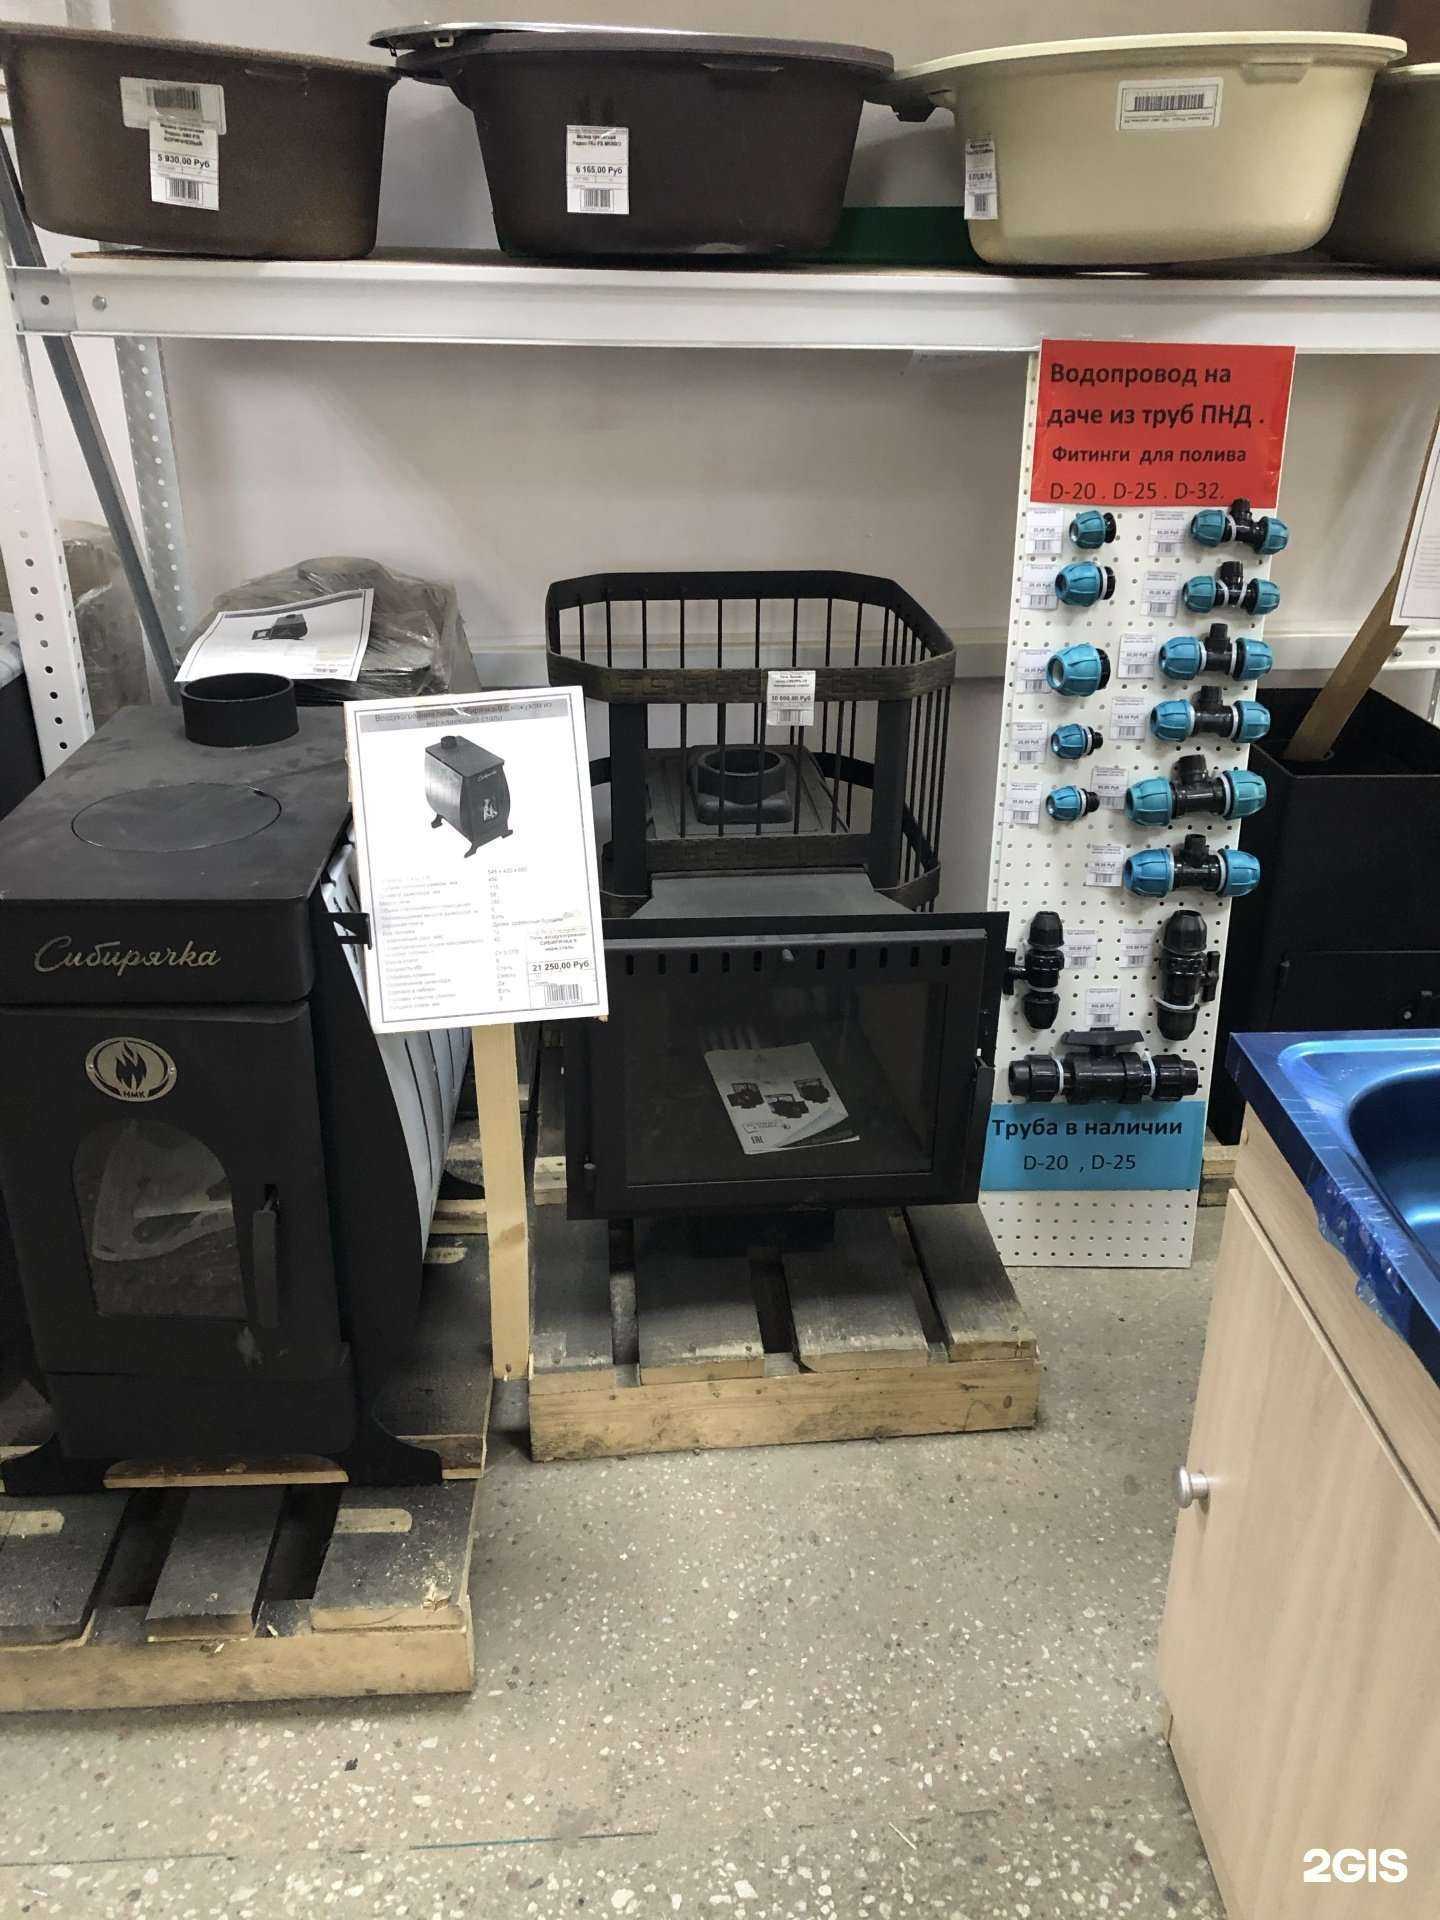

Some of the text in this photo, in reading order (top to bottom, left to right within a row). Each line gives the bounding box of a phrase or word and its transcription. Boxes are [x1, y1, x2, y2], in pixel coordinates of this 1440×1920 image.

[157, 154, 210, 169] 5 930,00 Руб
[608, 167, 623, 176] Руб
[1050, 363, 1232, 387] Водопровод на
[1047, 408, 1104, 428] даче
[1110, 409, 1136, 424] из
[1142, 403, 1195, 429] труб
[1200, 404, 1253, 428] ПНД
[1052, 446, 1247, 464] Фитинги для полива
[1050, 482, 1097, 500] D-20
[1113, 483, 1158, 500] D-25
[34, 935, 222, 977] Сибирячка
[532, 960, 590, 972] 21 250,00 Руб
[991, 1117, 1182, 1140] Труба в наличии
[1023, 1154, 1069, 1170] D-20
[1091, 1154, 1137, 1170] D-25
